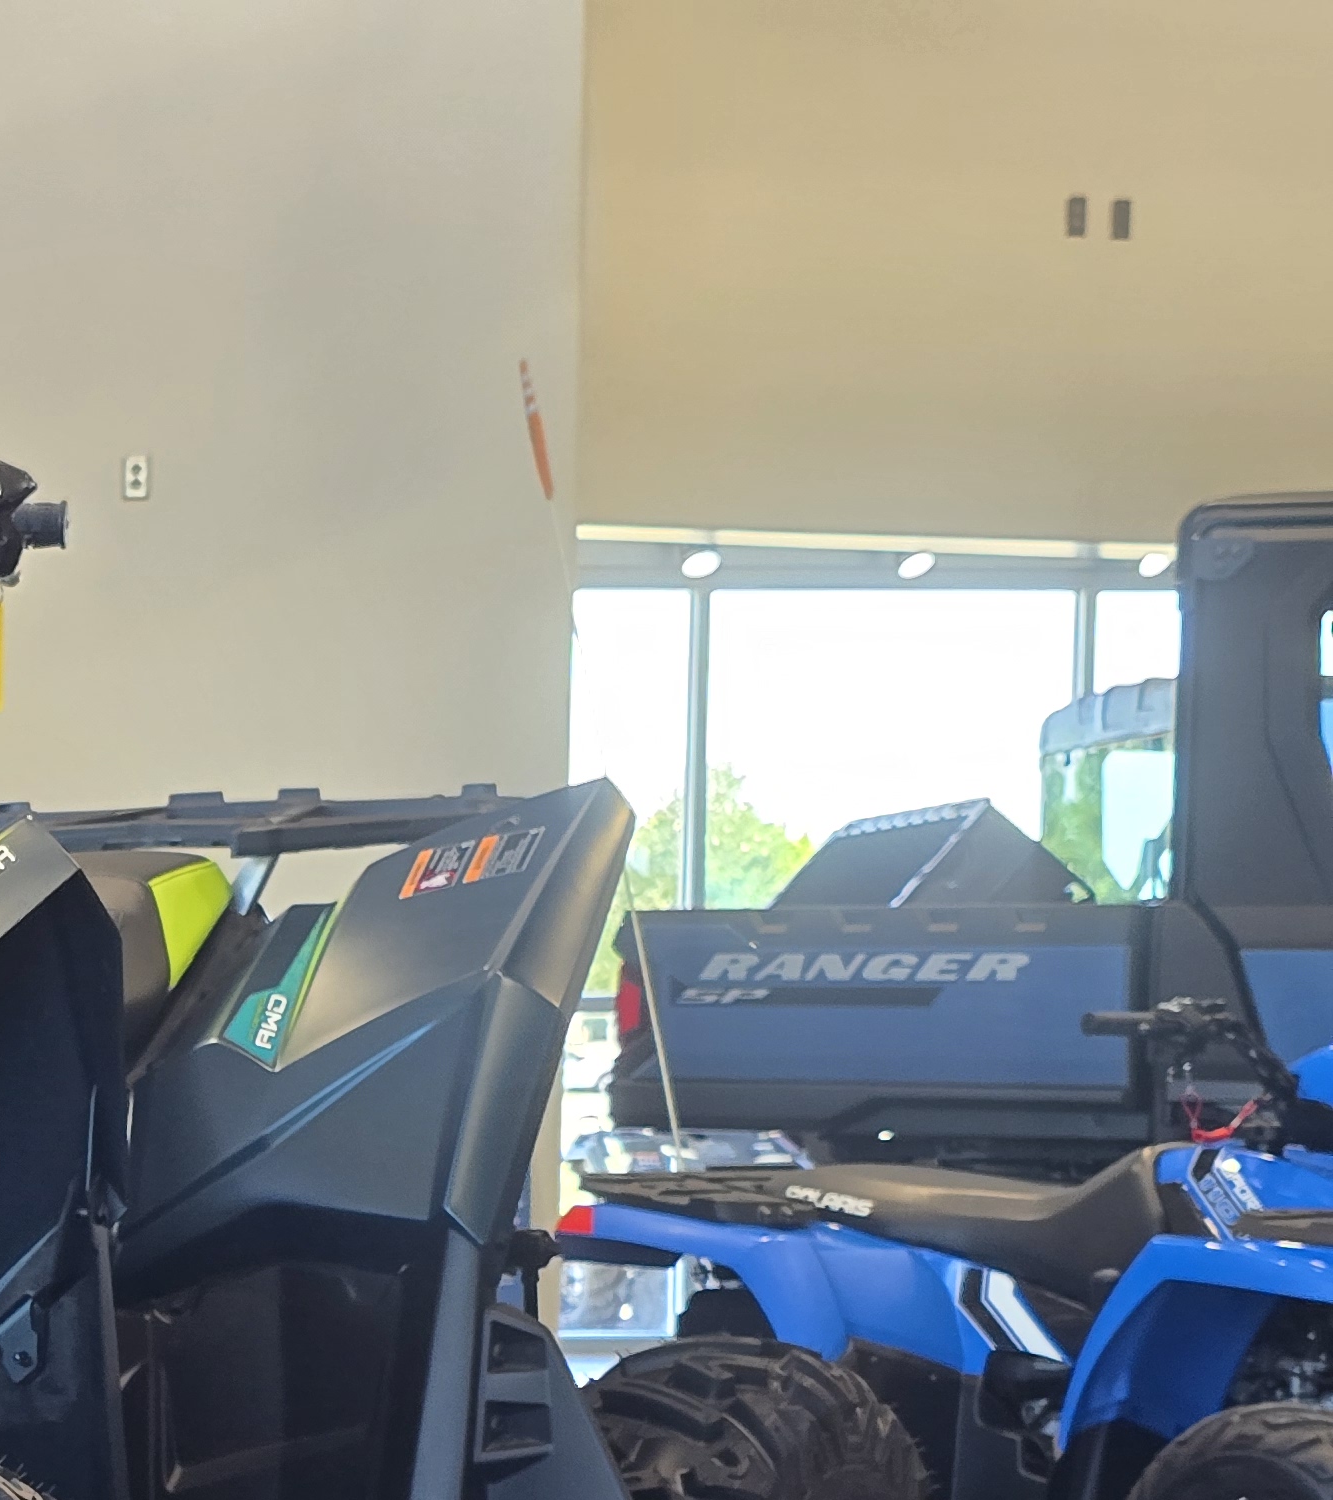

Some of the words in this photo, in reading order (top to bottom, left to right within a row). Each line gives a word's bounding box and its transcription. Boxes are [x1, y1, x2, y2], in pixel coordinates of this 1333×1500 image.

[697, 952, 1031, 982] RANGER
[254, 993, 288, 1049] AWD
[785, 1185, 874, 1217] POLARIS
